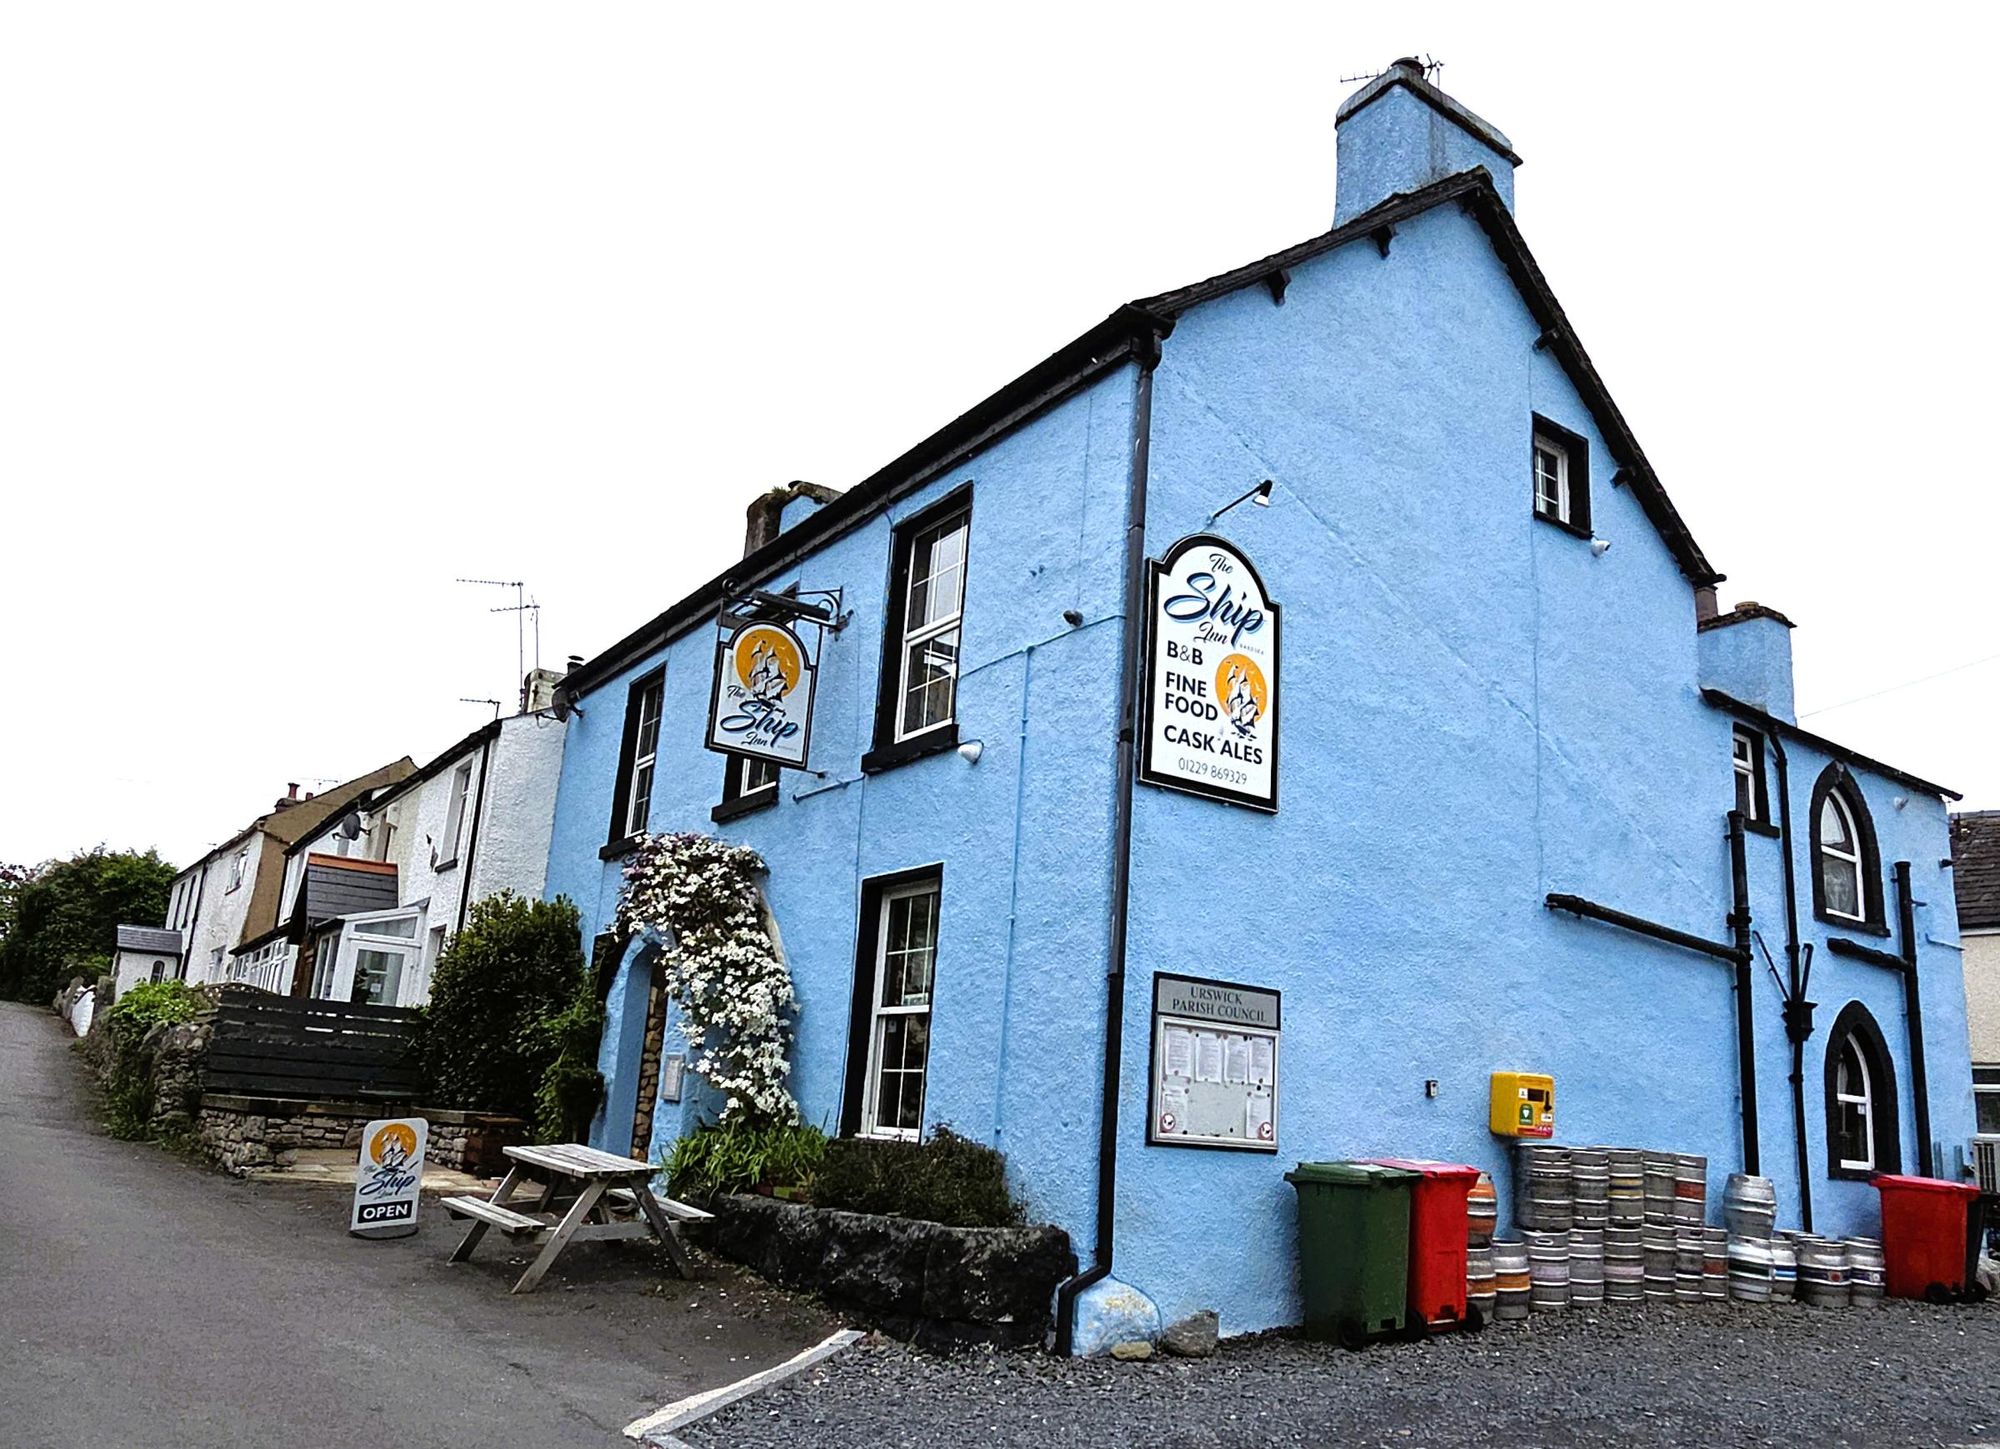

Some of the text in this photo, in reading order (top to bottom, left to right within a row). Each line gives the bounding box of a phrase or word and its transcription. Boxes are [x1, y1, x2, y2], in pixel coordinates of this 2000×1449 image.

[1209, 553, 1233, 573] The
[1163, 572, 1264, 650] Ship
[1193, 621, 1228, 644] Inn
[1167, 640, 1204, 665] B&B
[1166, 671, 1207, 698] FINE
[1165, 692, 1218, 721] FOOD
[720, 700, 799, 748] Ship
[741, 731, 768, 746] Inn
[1164, 725, 1263, 765] CASK ALES
[1178, 757, 1248, 785] 01229 869329
[1191, 986, 1242, 1005] URSWICK
[1172, 998, 1267, 1022] PARISH COUNCIL
[363, 1203, 408, 1219] OPEN
